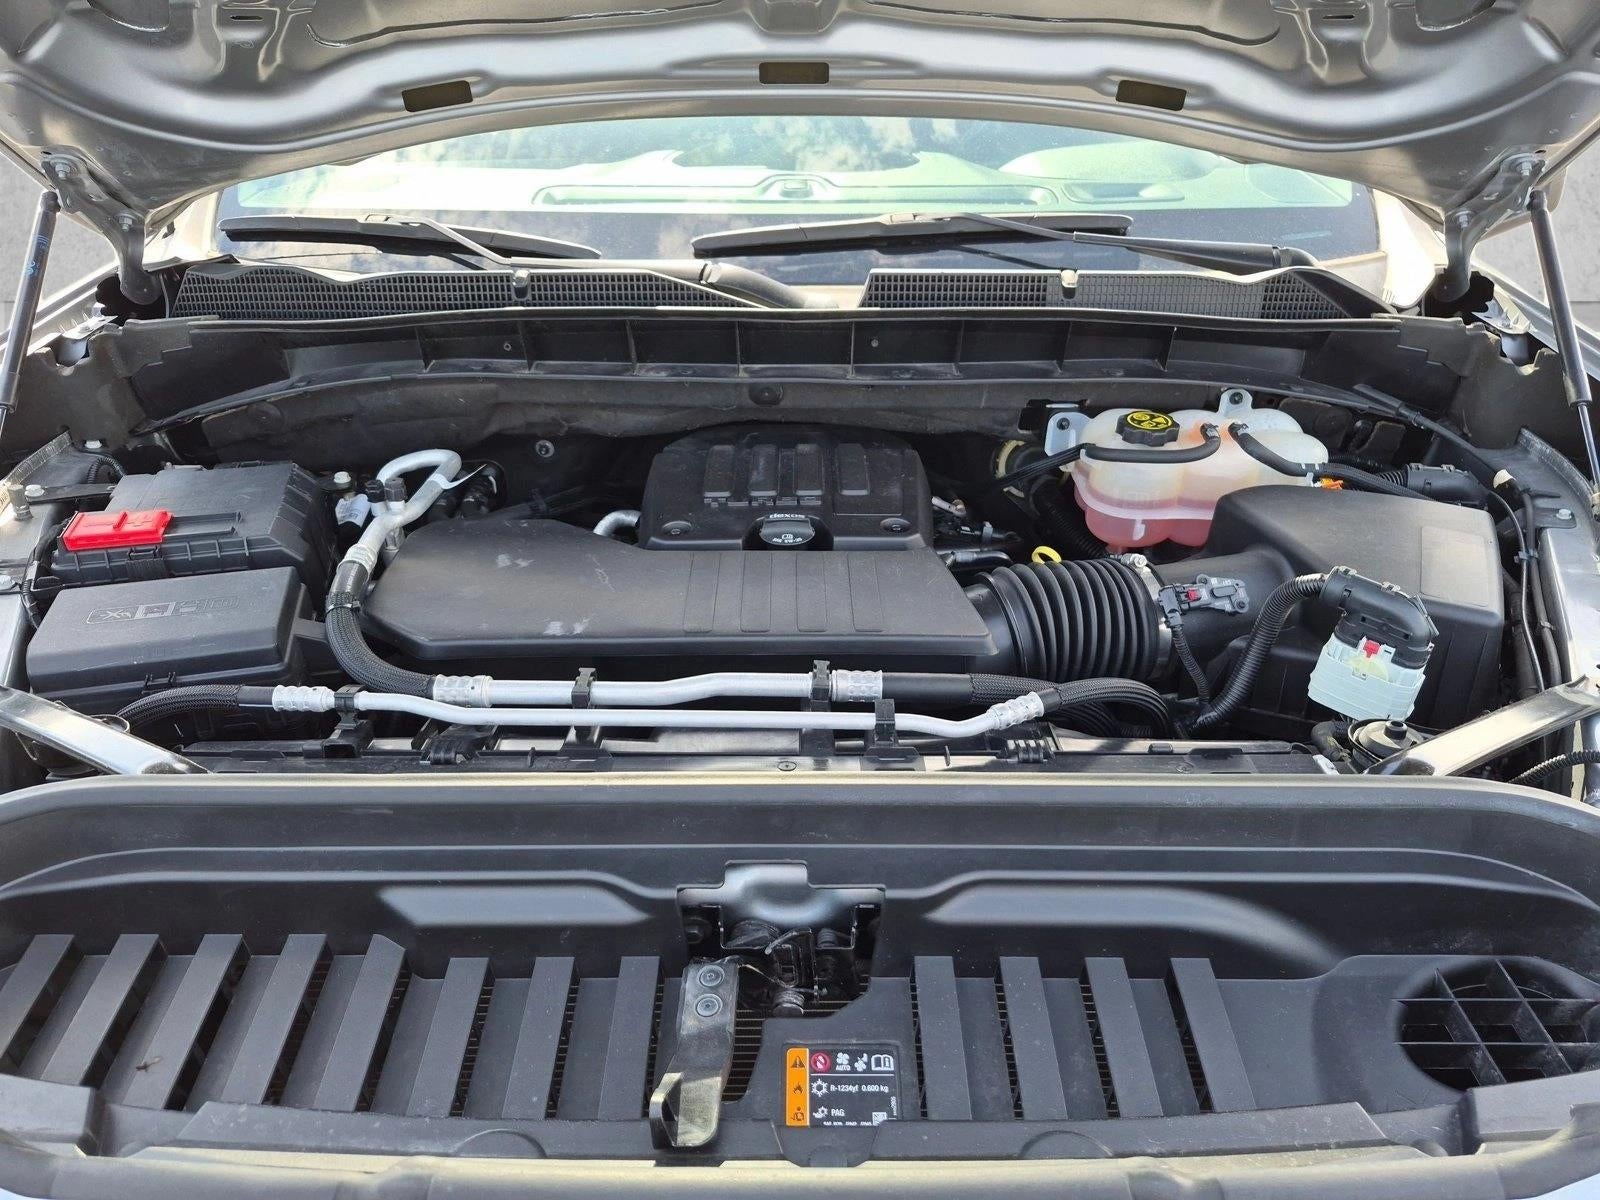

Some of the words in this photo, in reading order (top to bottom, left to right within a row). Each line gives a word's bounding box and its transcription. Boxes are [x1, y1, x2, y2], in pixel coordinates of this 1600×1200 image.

[830, 1085, 859, 1093] R-1234yf
[880, 1085, 889, 1093] kg
[831, 1109, 845, 1117] PAG
